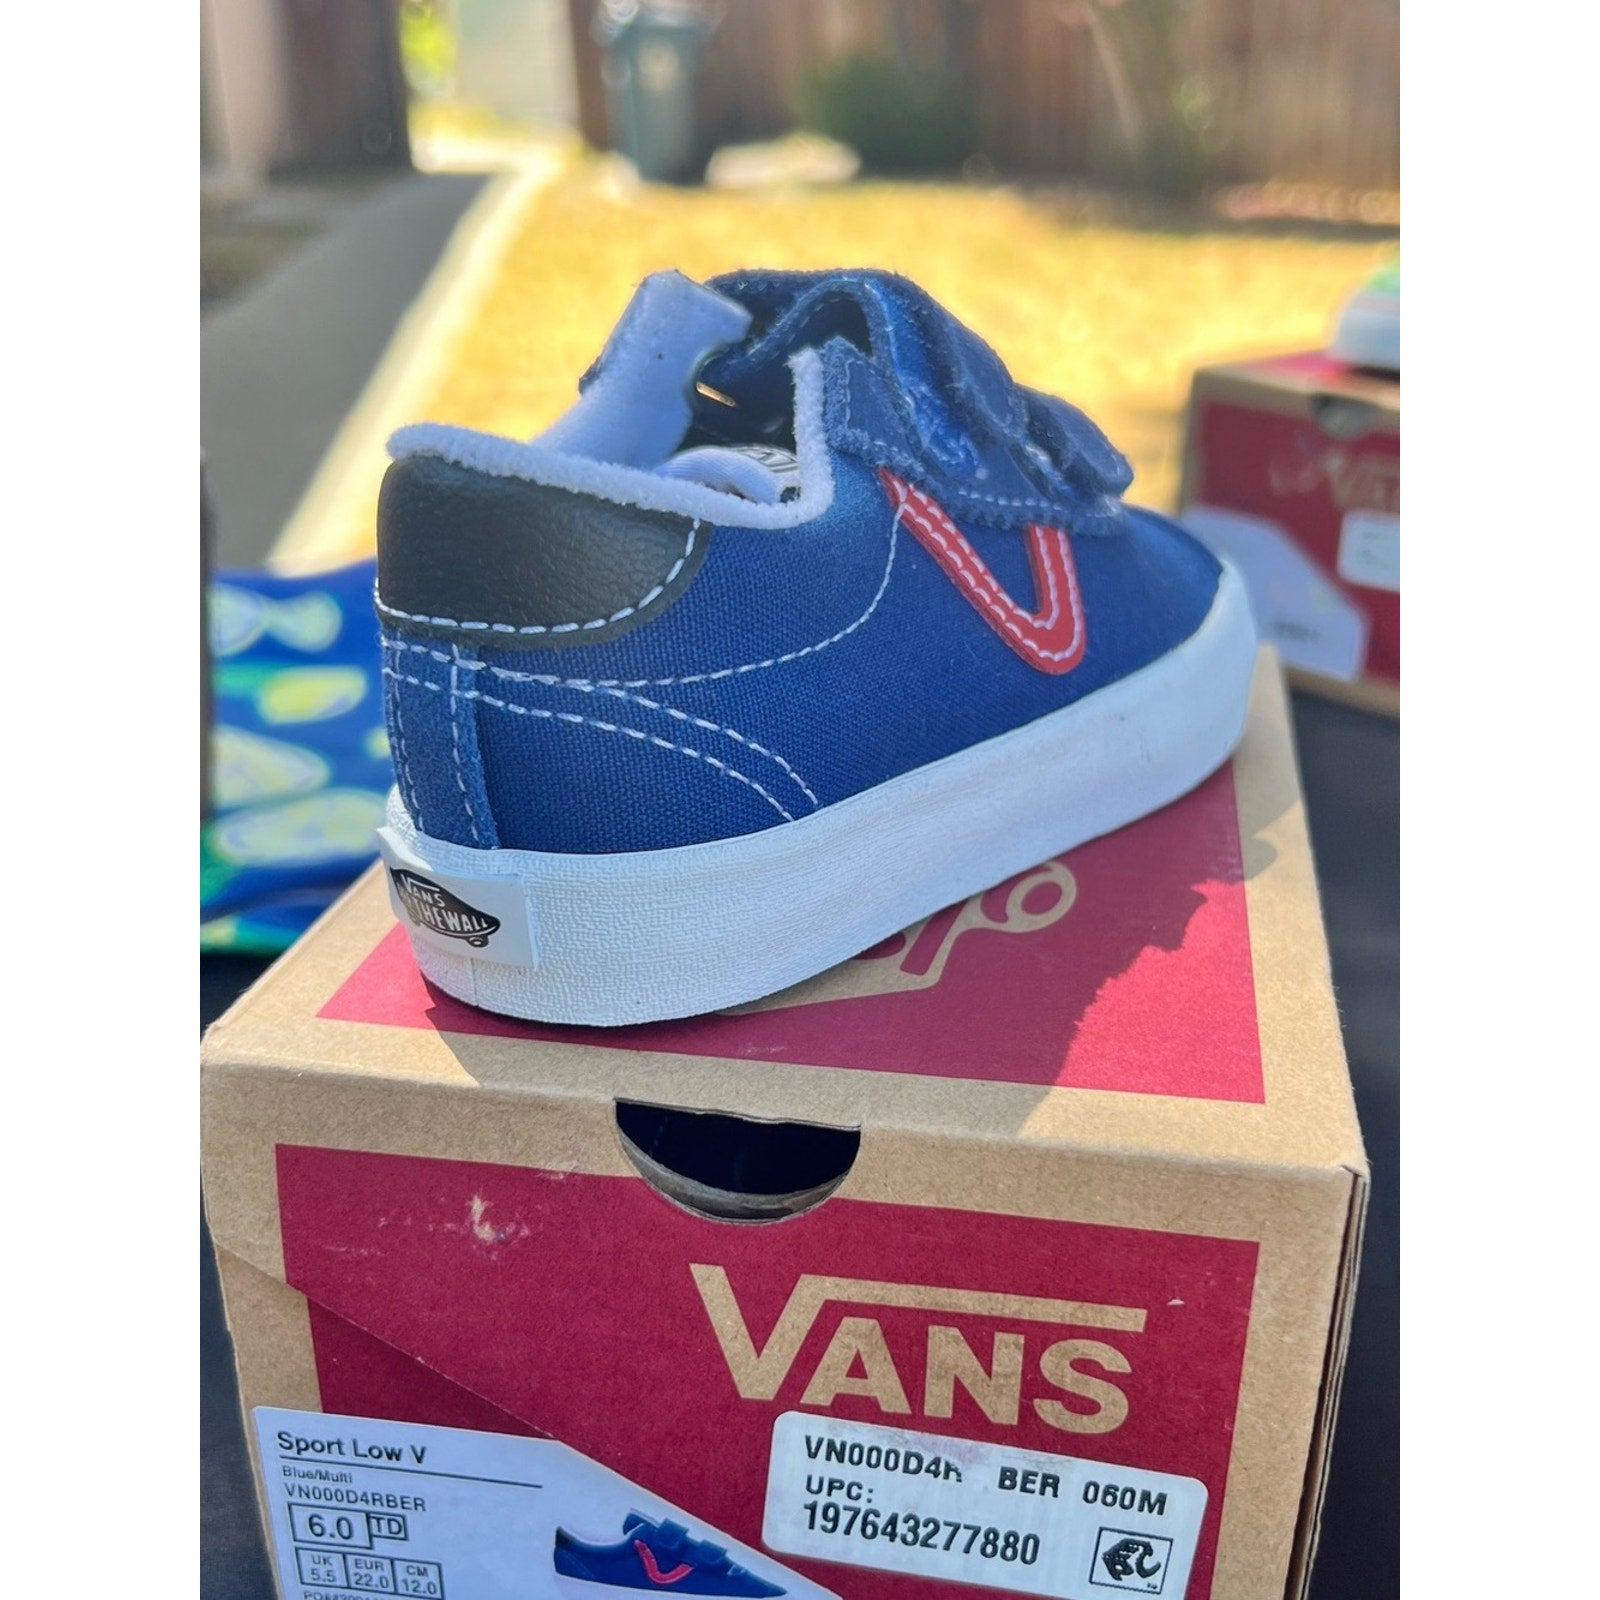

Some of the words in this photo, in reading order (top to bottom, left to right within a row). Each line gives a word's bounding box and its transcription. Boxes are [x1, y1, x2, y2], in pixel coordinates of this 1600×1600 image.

[401, 873, 446, 908] VANS
[689, 1263, 1148, 1434] VANS
[277, 1431, 345, 1456] Sport
[352, 1438, 402, 1461] Low
[410, 1445, 427, 1464] V
[282, 1465, 353, 1484] Blue/Multi
[804, 1474, 874, 1503] UPC:
[283, 1483, 427, 1512] VN000D4RBER
[998, 1466, 1060, 1498] BER
[1082, 1480, 1168, 1516] 060M
[307, 1513, 354, 1540] 6.0
[374, 1516, 402, 1536] TD
[803, 1502, 1040, 1566] 197643277880
[311, 1553, 333, 1566] UK
[354, 1559, 385, 1573] EUR
[406, 1565, 428, 1578] CM
[310, 1567, 337, 1583] 5.5
[353, 1572, 390, 1590] 22.0
[401, 1576, 437, 1595] 12.0
